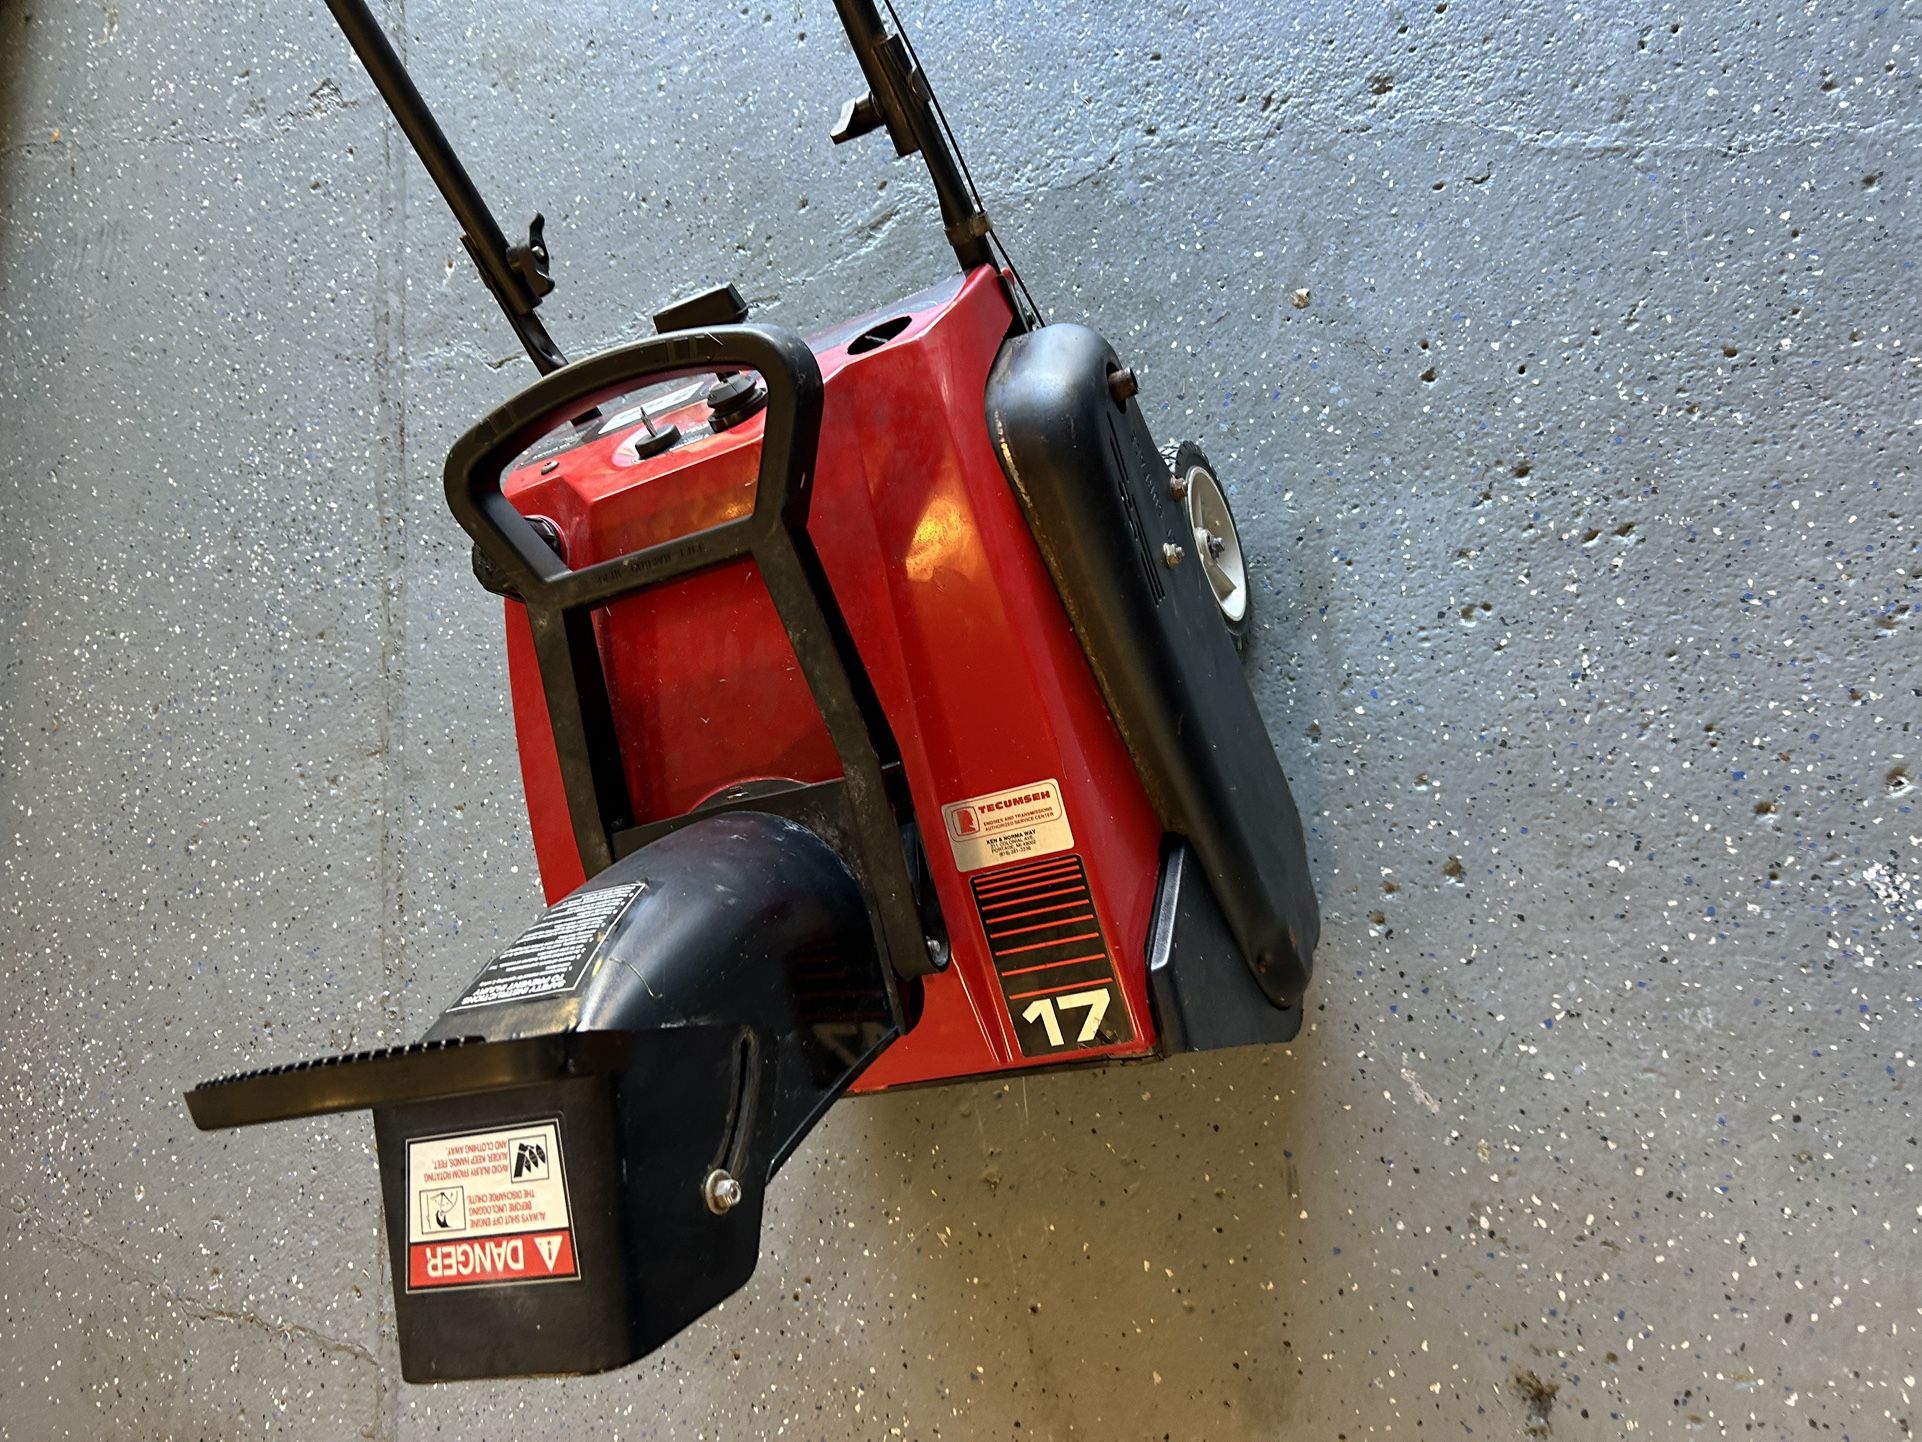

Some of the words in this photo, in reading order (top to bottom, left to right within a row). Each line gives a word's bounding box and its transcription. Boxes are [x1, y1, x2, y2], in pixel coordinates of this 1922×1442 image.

[978, 791, 1051, 814] TECUMSEH
[983, 818, 1003, 826] ENGINES
[1015, 806, 1053, 818] TRANSMISSIONS
[985, 821, 1014, 831] AUTHORIZED
[1014, 816, 1034, 825] SERVICE
[1035, 811, 1054, 820] CENTER
[1003, 832, 1024, 841] NORMA
[508, 976, 551, 990] PREVENT
[552, 973, 565, 983] TO
[472, 983, 507, 996] INJURY
[528, 979, 566, 993] SAFETY
[461, 986, 529, 1005] INSTRUCTIONS
[1022, 988, 1111, 1047] 17
[465, 1142, 494, 1153] CLOTHING
[494, 1140, 507, 1150] AND
[470, 1155, 486, 1165] KEEP
[452, 1168, 469, 1178] FROM
[470, 1166, 491, 1177] INJURY
[491, 1164, 508, 1174] AVOID
[423, 1171, 452, 1182] ROTATING
[489, 1190, 522, 1202] DISCHARGE
[523, 1189, 535, 1199] THE
[468, 1204, 507, 1216] UNCLOGGING
[509, 1201, 532, 1212] BEFORE
[470, 1217, 491, 1228] ENGINE
[492, 1216, 504, 1226] OFF
[505, 1215, 520, 1226] SHUT
[521, 1212, 546, 1224] ALWAYS
[425, 1239, 525, 1277] DANGER
